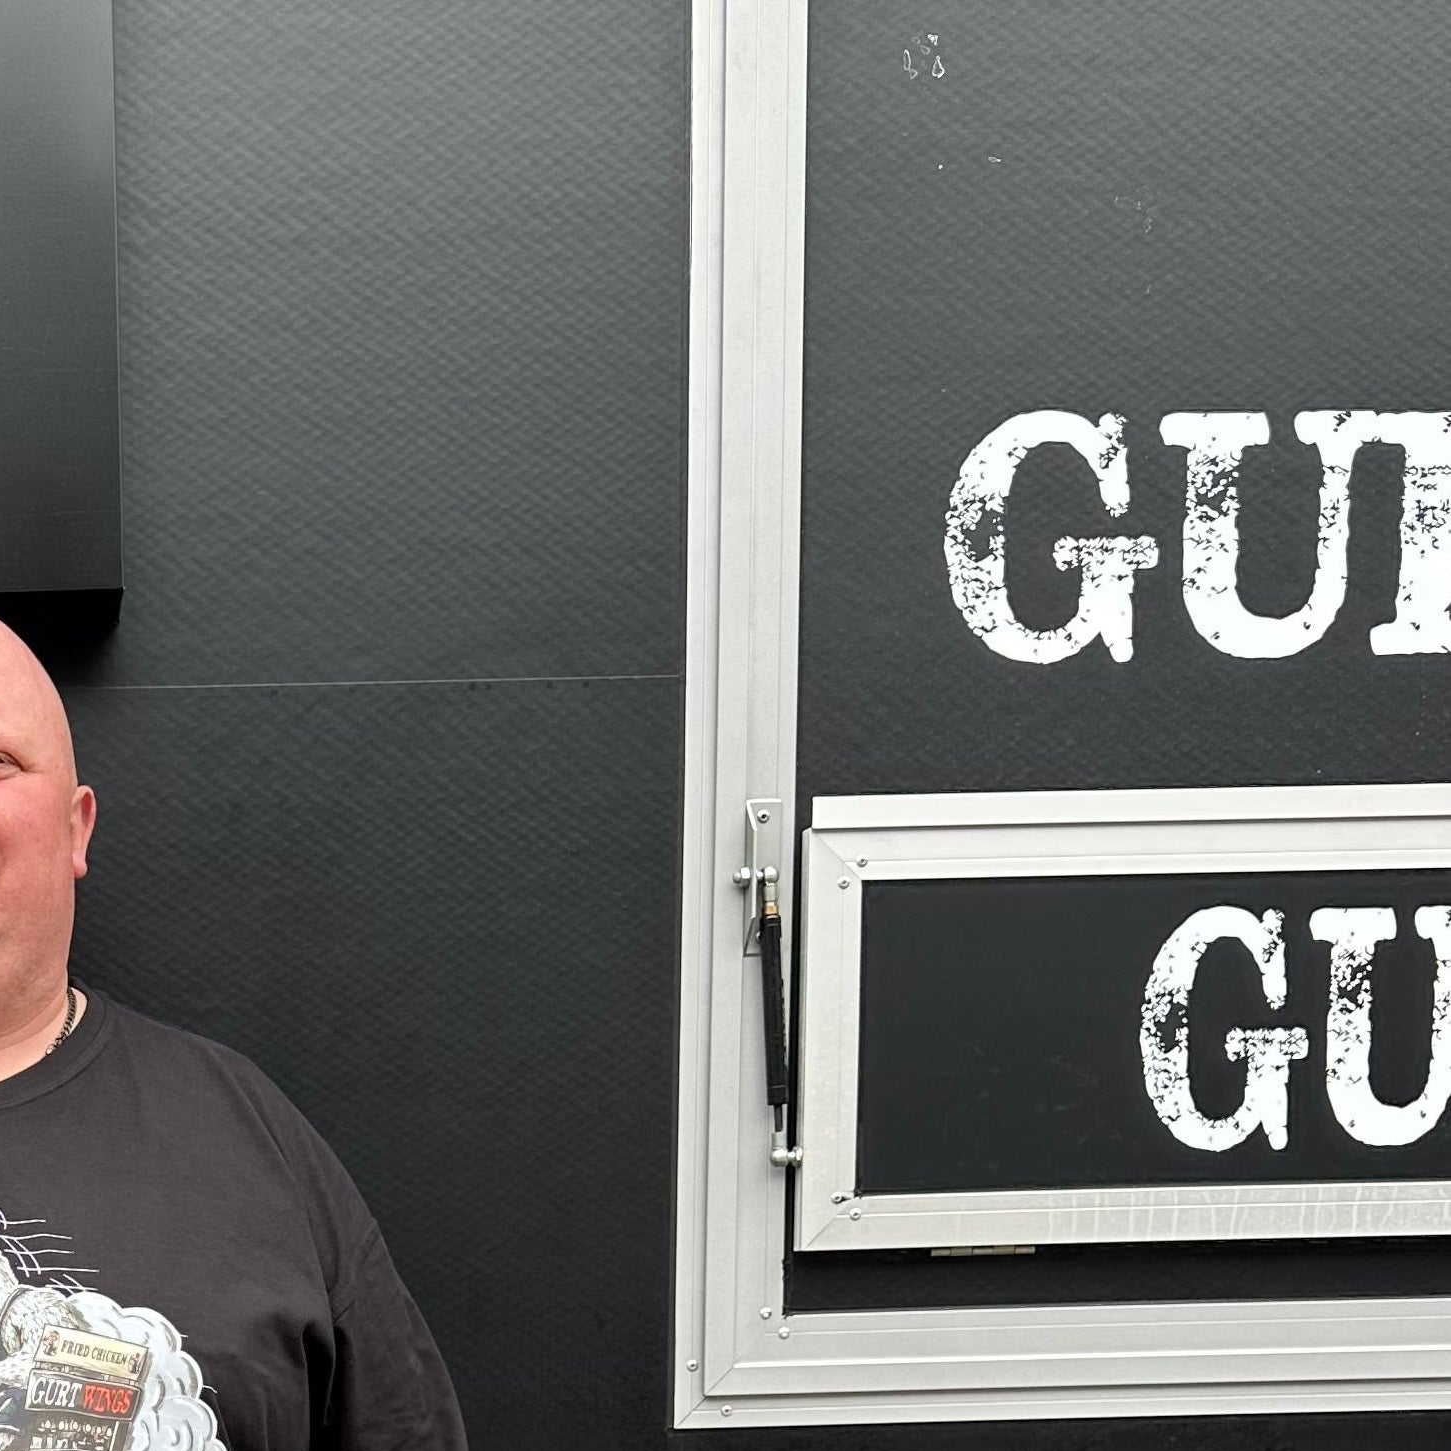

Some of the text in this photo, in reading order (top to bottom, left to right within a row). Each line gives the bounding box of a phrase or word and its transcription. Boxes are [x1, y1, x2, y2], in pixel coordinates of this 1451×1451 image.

[61, 1340, 128, 1366] FRIED CHICKEN
[31, 1376, 133, 1414] GURT WINGS
